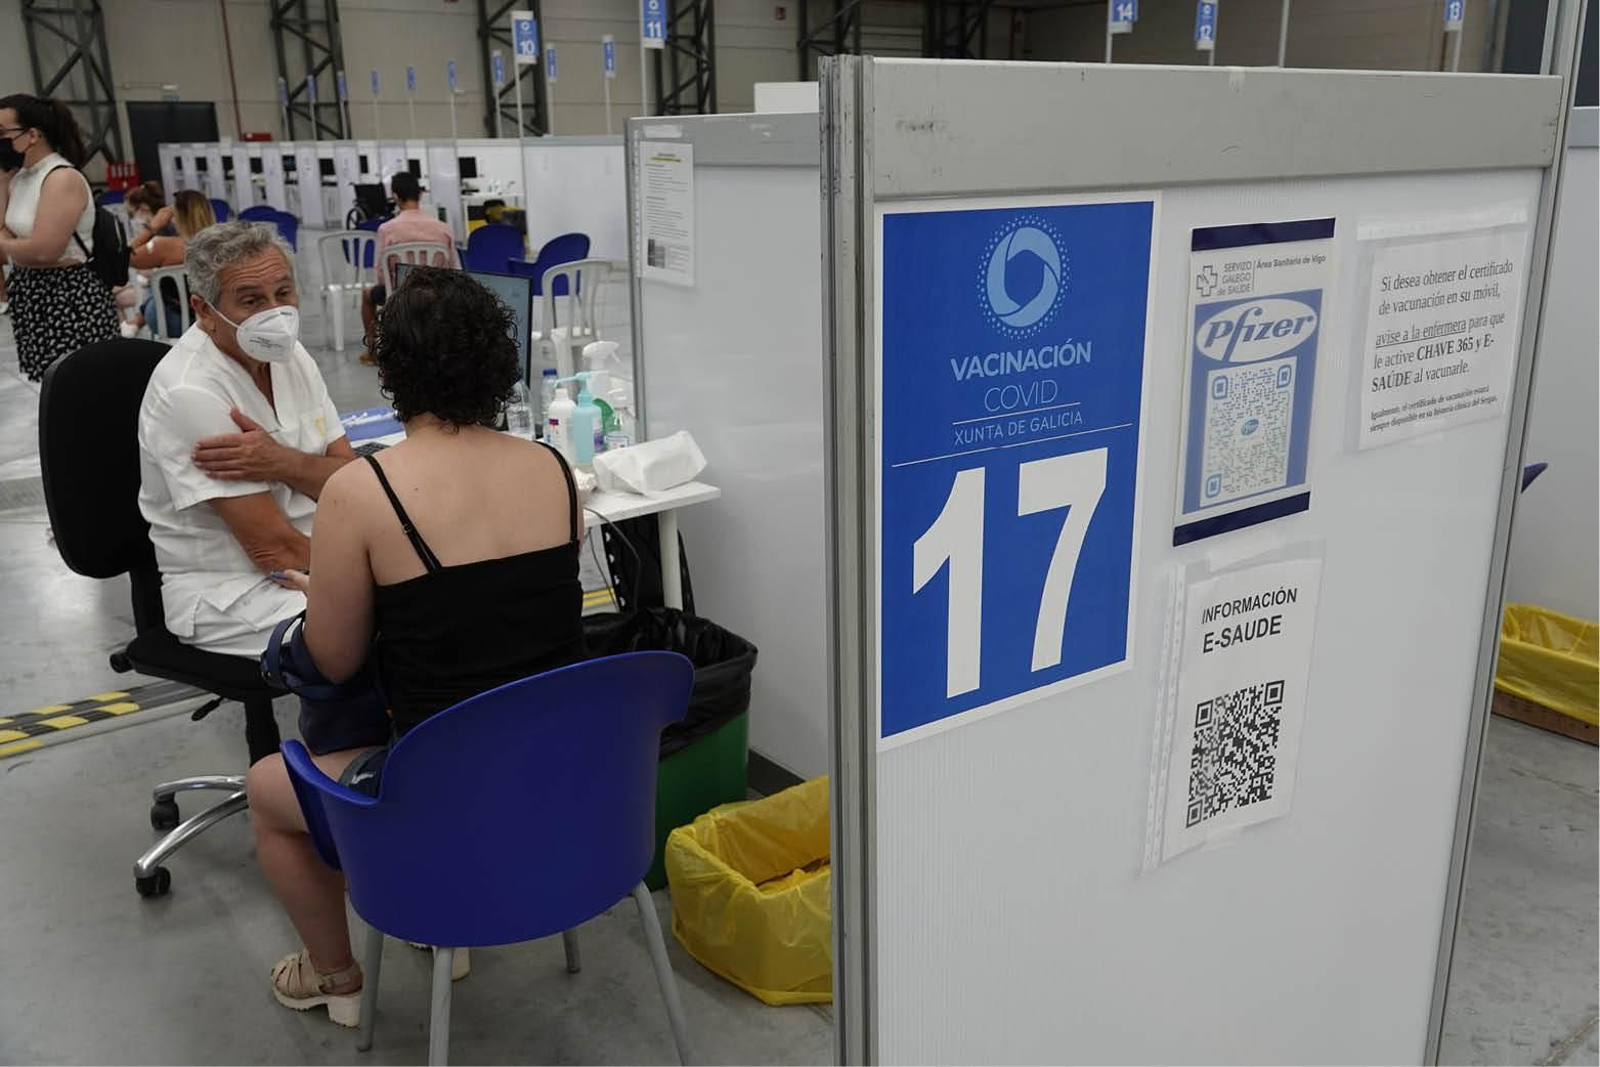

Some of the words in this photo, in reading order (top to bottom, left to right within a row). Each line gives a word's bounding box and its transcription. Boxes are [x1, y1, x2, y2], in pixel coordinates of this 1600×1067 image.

[1116, 2, 1133, 20] 14
[647, 21, 662, 38] 11
[519, 40, 536, 55] 10
[1224, 261, 1252, 273] SERVIZO
[1312, 254, 1326, 265] Vigo
[1381, 276, 1391, 292] Si
[1393, 274, 1420, 291] desea
[1423, 270, 1457, 287] obtener
[1458, 265, 1467, 281] el
[1470, 259, 1514, 279] certificado
[1222, 272, 1251, 284] GALEGO
[1378, 299, 1391, 316] de
[1392, 291, 1446, 313] vacunación
[1446, 293, 1458, 305] en
[1460, 290, 1471, 303] su
[1473, 282, 1501, 301] móvil,
[1204, 306, 1315, 363] Pfizer
[1376, 328, 1401, 346] avise
[1402, 329, 1409, 341] a
[1411, 323, 1421, 340] la
[1423, 319, 1467, 338] enfermera
[1468, 314, 1488, 333] para
[1489, 311, 1506, 329] que
[950, 338, 1092, 382] VACINACIÓN
[1374, 354, 1383, 369] le
[1384, 350, 1415, 368] active
[1417, 340, 1455, 361] CHAVE
[1456, 337, 1474, 353] 365
[1476, 338, 1481, 353] y
[1483, 333, 1495, 348] E-
[1371, 370, 1412, 393] SAÚDE
[1413, 368, 1423, 385] al
[1426, 359, 1471, 380] vacunarle.
[984, 379, 1059, 412] COVID
[954, 424, 1004, 446] XUNTA
[1007, 419, 1027, 437] DE
[1030, 410, 1084, 433] GALICIA
[913, 447, 1108, 699] 17
[1202, 586, 1298, 625] INFORMACIÓN
[1203, 614, 1283, 654] E-SAUDE
